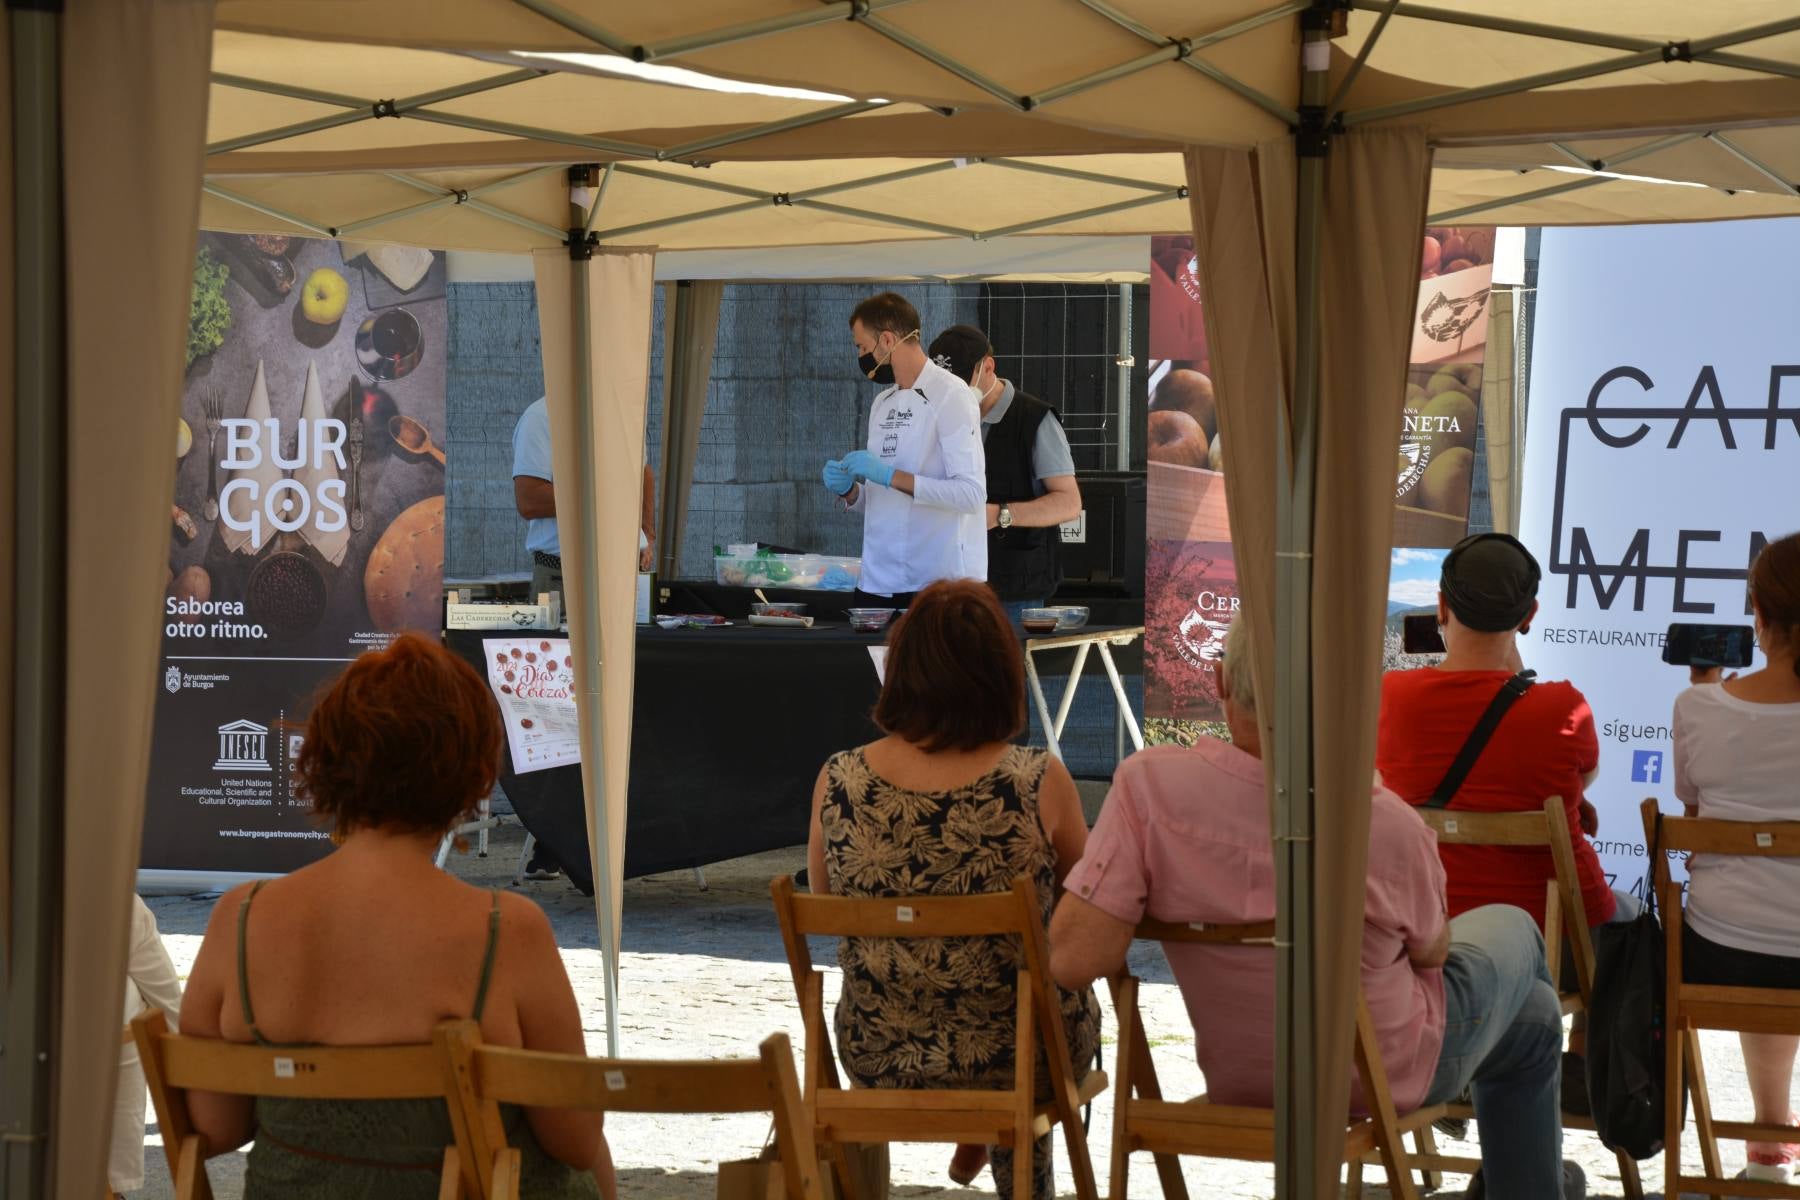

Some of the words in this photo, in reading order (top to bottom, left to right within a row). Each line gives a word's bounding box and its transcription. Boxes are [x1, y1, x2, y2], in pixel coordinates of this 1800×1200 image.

[1403, 416, 1461, 432] NETA
[220, 418, 347, 470] BUR
[219, 478, 347, 549] GOS
[166, 596, 244, 616] Saborea
[166, 621, 206, 638] otro
[210, 619, 268, 639] ritmo.
[1543, 628, 1668, 648] RESTAURANTE
[1172, 634, 1191, 662] VALLE
[1190, 657, 1202, 669] DE
[1203, 663, 1215, 672] LA
[183, 673, 230, 682] Ayuntamiento
[192, 681, 214, 689] Burgos
[220, 734, 266, 760] UNESCO
[181, 787, 223, 796] Educational,
[225, 788, 257, 797] Scientific
[258, 789, 272, 797] and
[221, 779, 243, 787] United
[245, 779, 272, 788] Nations
[199, 796, 226, 805] Cultural
[227, 797, 272, 807] Organization
